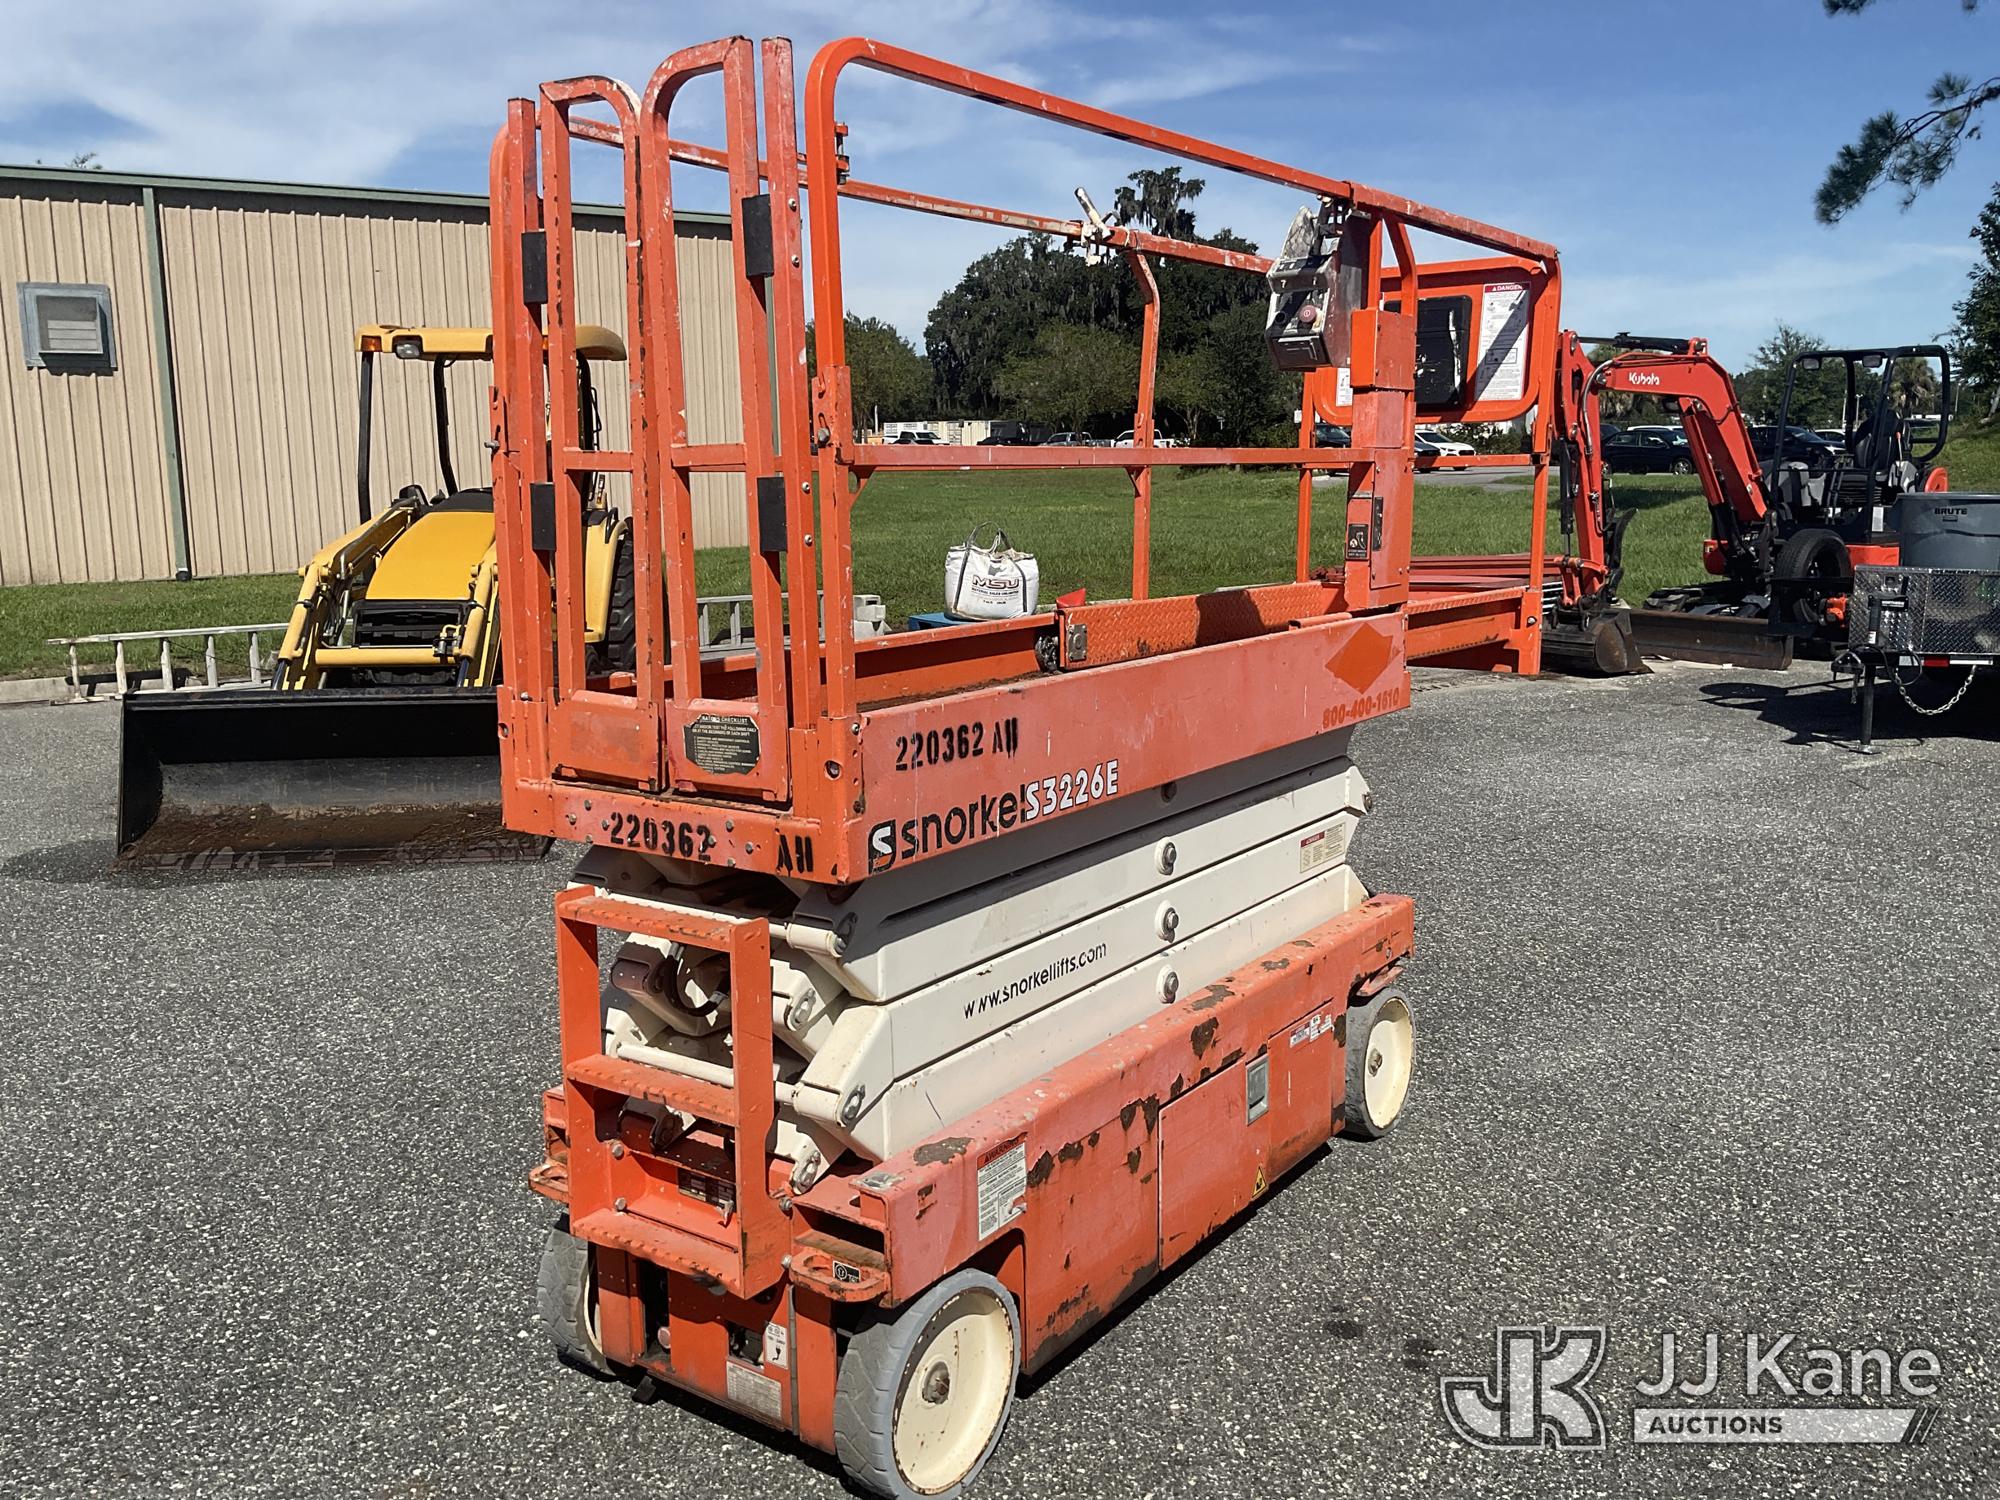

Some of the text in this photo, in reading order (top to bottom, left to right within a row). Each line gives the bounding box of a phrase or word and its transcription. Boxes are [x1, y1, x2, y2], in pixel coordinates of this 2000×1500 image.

[1628, 372, 1660, 385] Kubota
[1934, 507, 1968, 515] BRUTE
[972, 575, 1020, 589] MSU
[895, 721, 984, 771] 220362
[901, 784, 1026, 859] snorkel
[1026, 759, 1119, 821] S3226E
[610, 811, 713, 862] 220362
